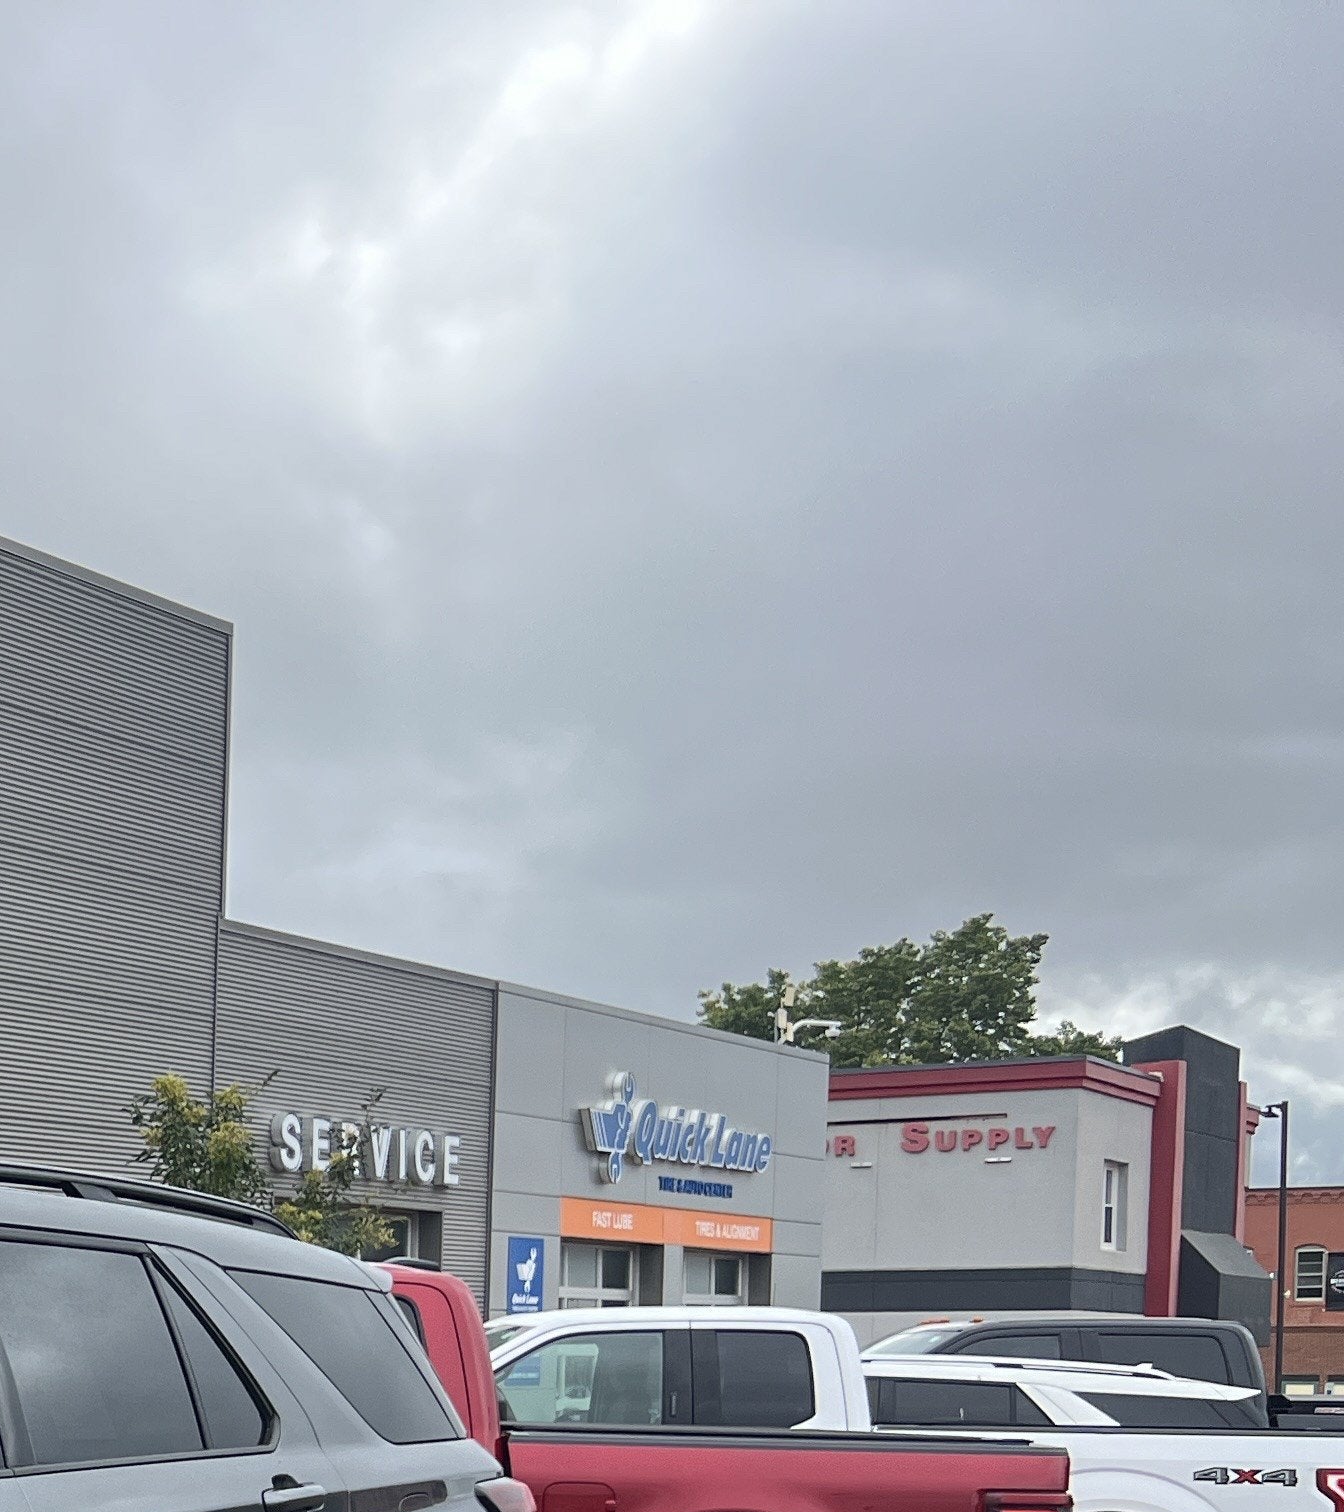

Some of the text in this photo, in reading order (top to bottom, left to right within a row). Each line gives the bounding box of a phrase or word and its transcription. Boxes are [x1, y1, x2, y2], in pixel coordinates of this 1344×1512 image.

[276, 1112, 462, 1185] SERVICE
[634, 1100, 773, 1174] Quick Lane
[592, 1211, 633, 1230] FAST LUBE
[695, 1221, 714, 1237] TIRES
[722, 1224, 760, 1241] ALIGNMENT
